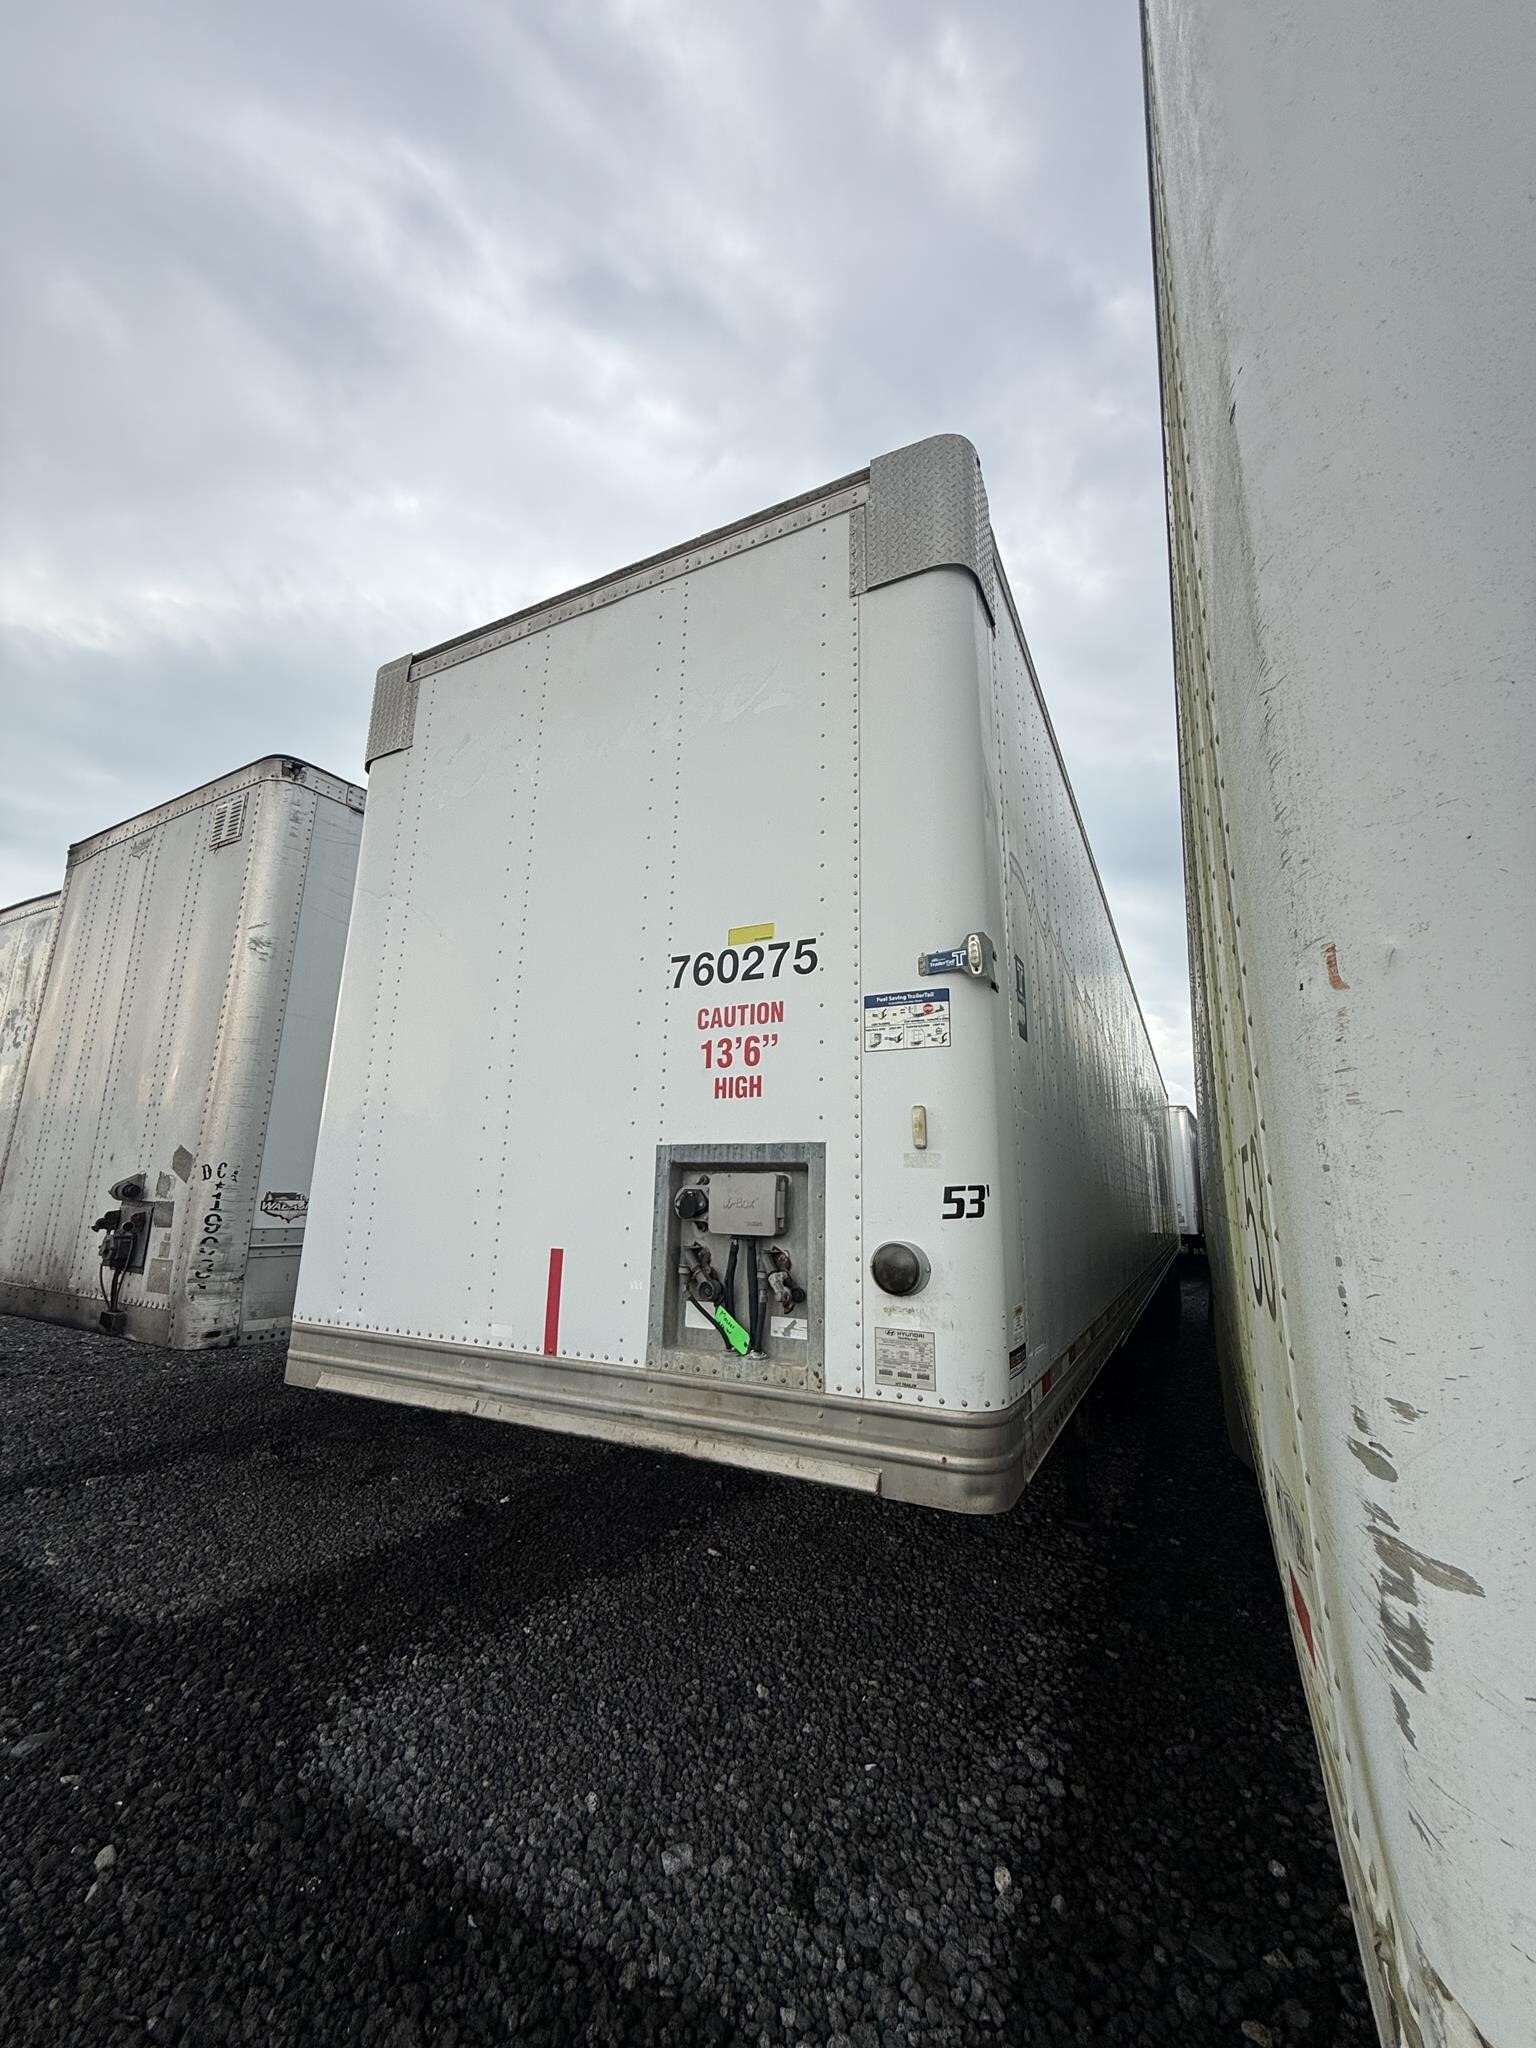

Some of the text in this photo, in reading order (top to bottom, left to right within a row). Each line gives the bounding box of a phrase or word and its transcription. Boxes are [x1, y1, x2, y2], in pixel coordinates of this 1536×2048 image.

[671, 938, 818, 988] 760275
[697, 1001, 784, 1030] CAUTION
[888, 994, 907, 1002] Saving
[701, 1034, 778, 1069] 13'6"
[714, 1075, 762, 1099] HIGH
[942, 1184, 990, 1219] 53'
[1241, 1134, 1276, 1322] 53
